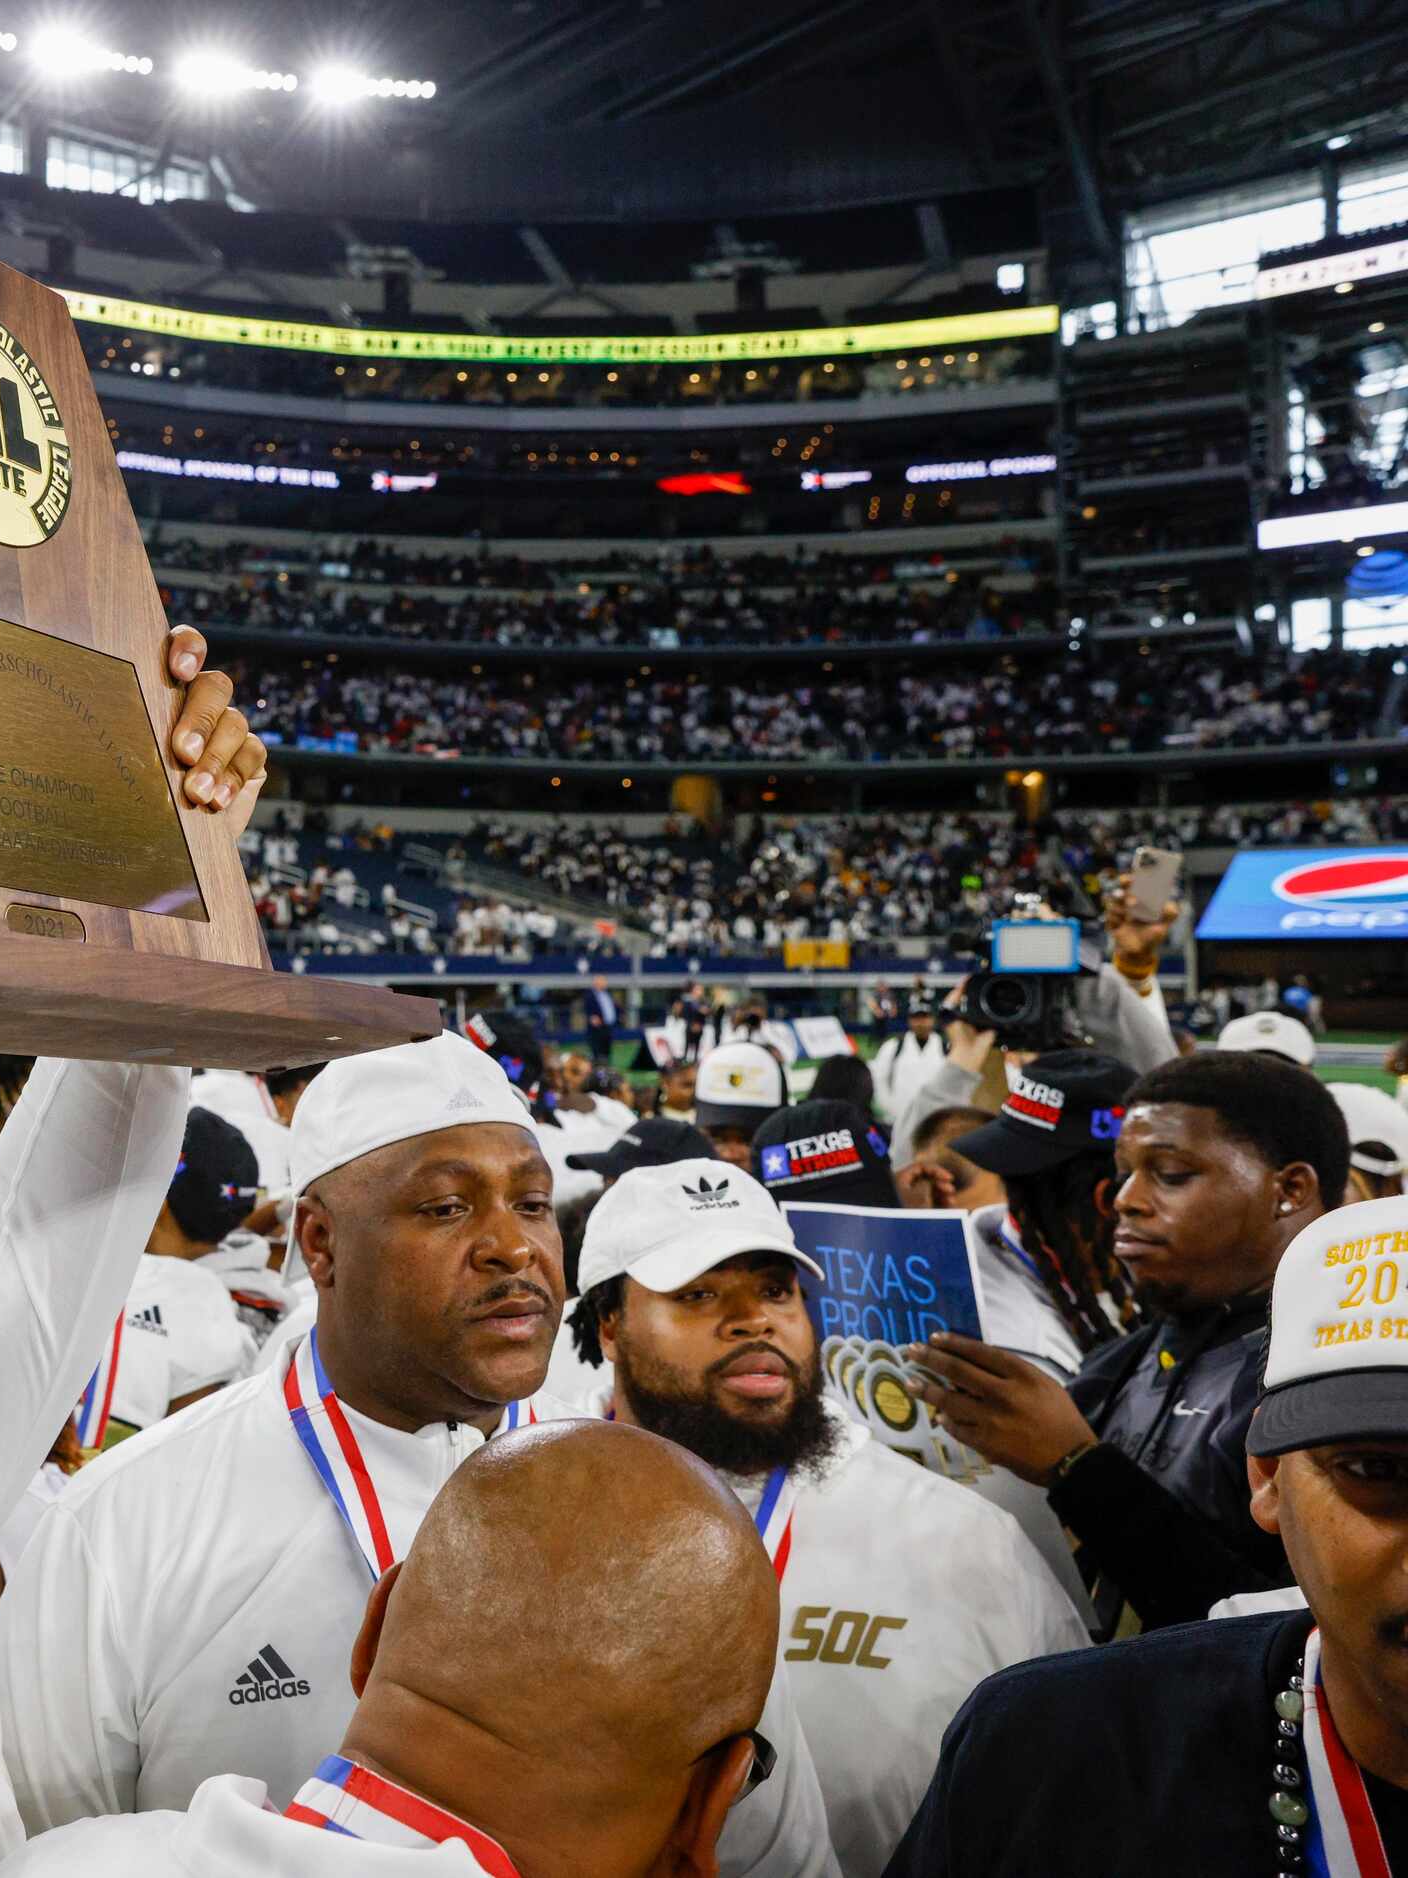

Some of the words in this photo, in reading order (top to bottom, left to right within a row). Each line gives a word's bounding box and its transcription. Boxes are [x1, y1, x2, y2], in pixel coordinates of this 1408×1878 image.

[116, 450, 183, 476] OFFICIAL
[183, 459, 254, 482] SPONSOR
[905, 459, 987, 484] OFFICIAL
[36, 446, 70, 533] LEAGUE
[10, 767, 96, 804] CHAMPION
[785, 1128, 855, 1160] TEXAS
[815, 1244, 938, 1305] TEXAS
[819, 1295, 949, 1347] PROUD
[1312, 1317, 1374, 1349] TEXAS
[783, 1605, 909, 1670] SOC
[228, 1678, 311, 1706] adidas
